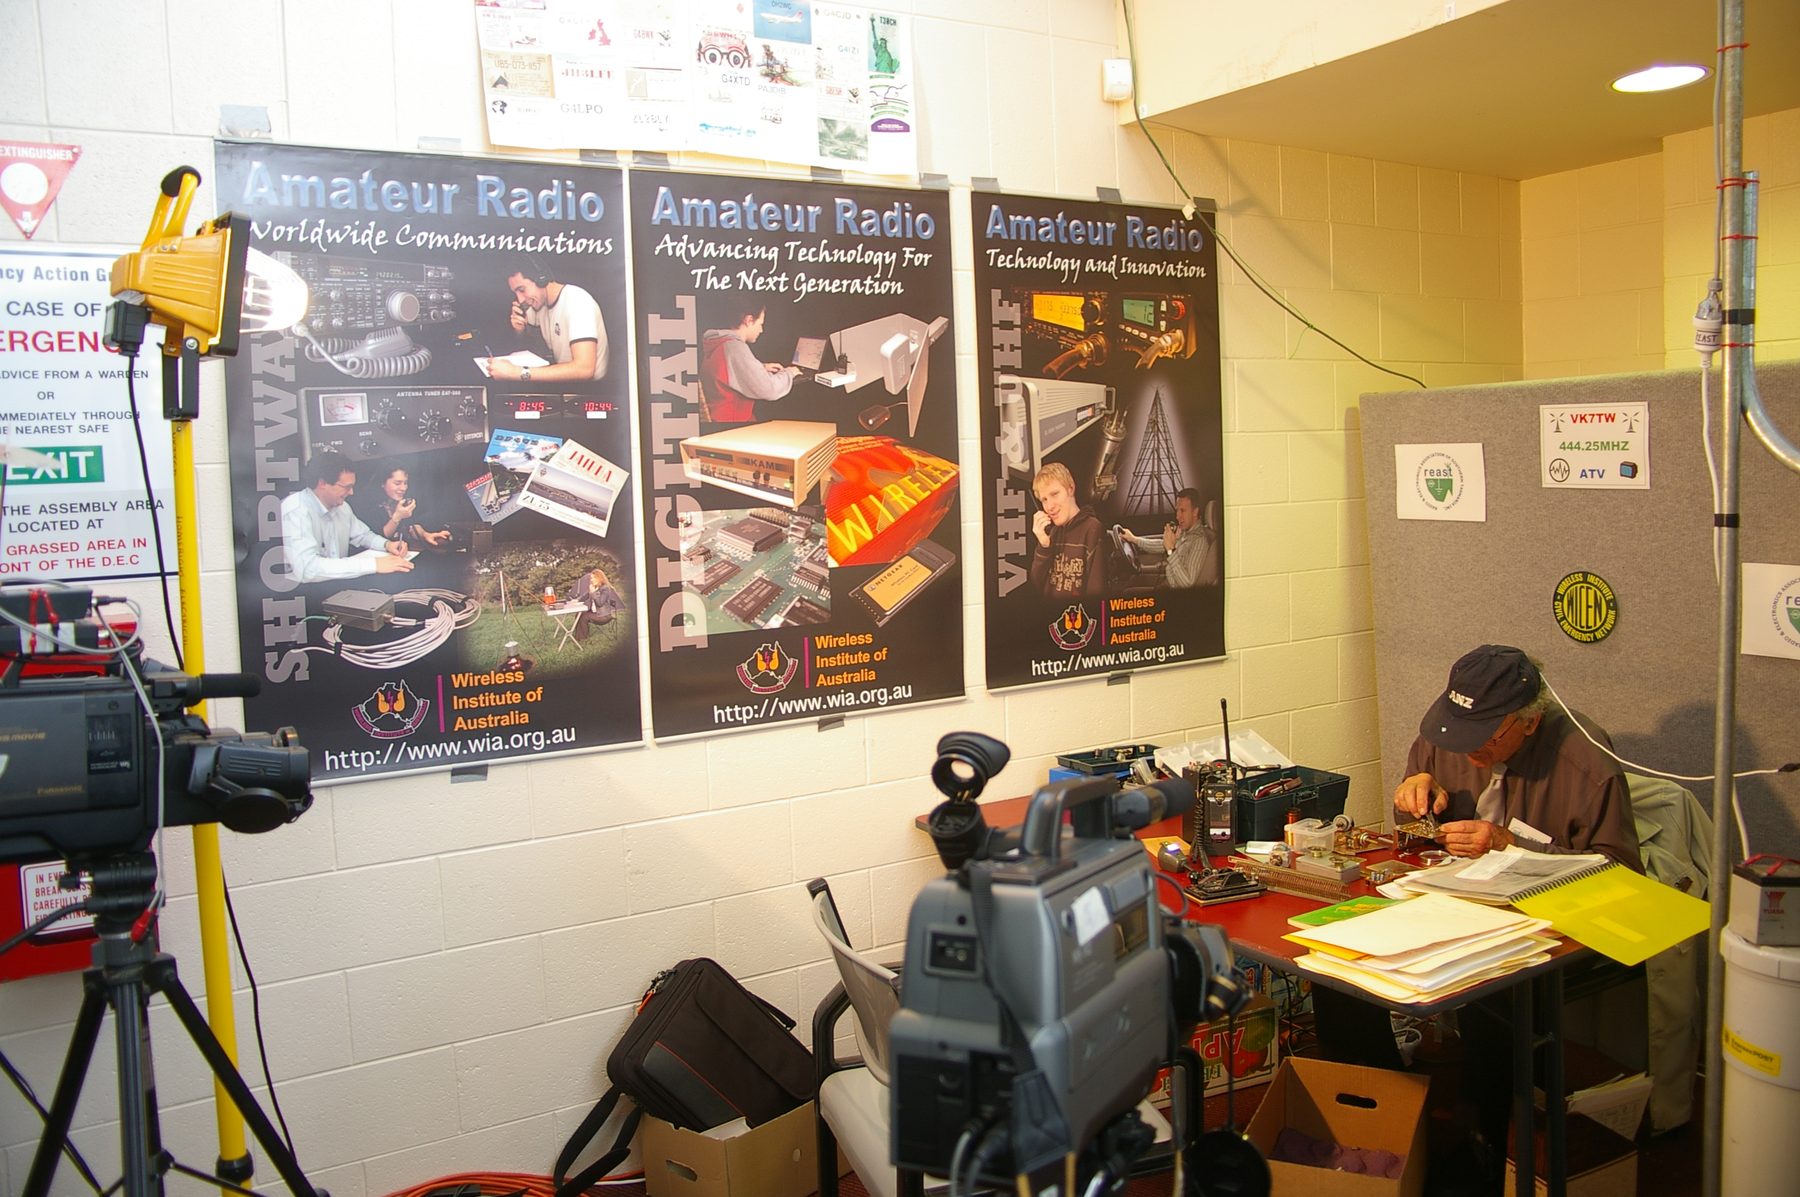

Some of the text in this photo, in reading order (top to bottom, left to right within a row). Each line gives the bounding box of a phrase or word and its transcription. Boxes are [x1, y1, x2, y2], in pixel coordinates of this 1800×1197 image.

[243, 160, 605, 222] Amateur Radio
[651, 186, 935, 240] Amateur Radio
[986, 204, 1204, 252] Amateur Radio
[395, 223, 613, 255] Communications
[654, 233, 933, 277] Advancing Technology For
[33, 266, 89, 282] Action
[986, 247, 1207, 284] Technology and Innovation
[691, 265, 904, 303] The Next Generation
[6, 302, 101, 317] CASE OF
[0, 369, 149, 380] DVICE FROM A WARDEN
[37, 391, 55, 400] OR
[1570, 412, 1616, 425] VK7TW
[16, 424, 73, 434] NEAREST
[79, 424, 109, 434] SAFE
[1559, 440, 1630, 452] 444.25MHZ
[648, 295, 709, 652] DIGITAL
[1424, 467, 1453, 477] reast
[1579, 468, 1606, 480] ATV
[39, 501, 118, 515] ASSEMBLY
[126, 499, 164, 511] AREA
[9, 518, 104, 534] LOCATED AT
[7, 537, 147, 556] GRASSED AREA IN
[996, 478, 1028, 597] VHF
[39, 559, 59, 571] OF
[66, 557, 96, 569] THE
[1557, 573, 1614, 601] WIRELESS INSTITUTE
[1110, 597, 1155, 611] Wireless
[1566, 585, 1603, 630] WICEN
[1110, 610, 1166, 628] Institute of
[1560, 620, 1594, 642] EMERGENCY
[1594, 609, 1616, 640] NETWORK
[814, 632, 873, 650] Wireless
[1110, 629, 1156, 645] Australia
[815, 647, 888, 669] Institute of
[1031, 642, 1185, 676] http://www.wia.org.au
[451, 670, 524, 689] Wireless
[816, 669, 876, 688] Australia
[452, 687, 543, 710] Institute of
[713, 683, 912, 724] http://www.wia.org.au
[1448, 690, 1474, 710] ANZ
[453, 711, 529, 732] Australia
[325, 726, 576, 770] http://www.wia.org.au
[36, 873, 44, 884] IN
[35, 885, 63, 898] BREAK
[34, 895, 79, 912] CAREFULLY
